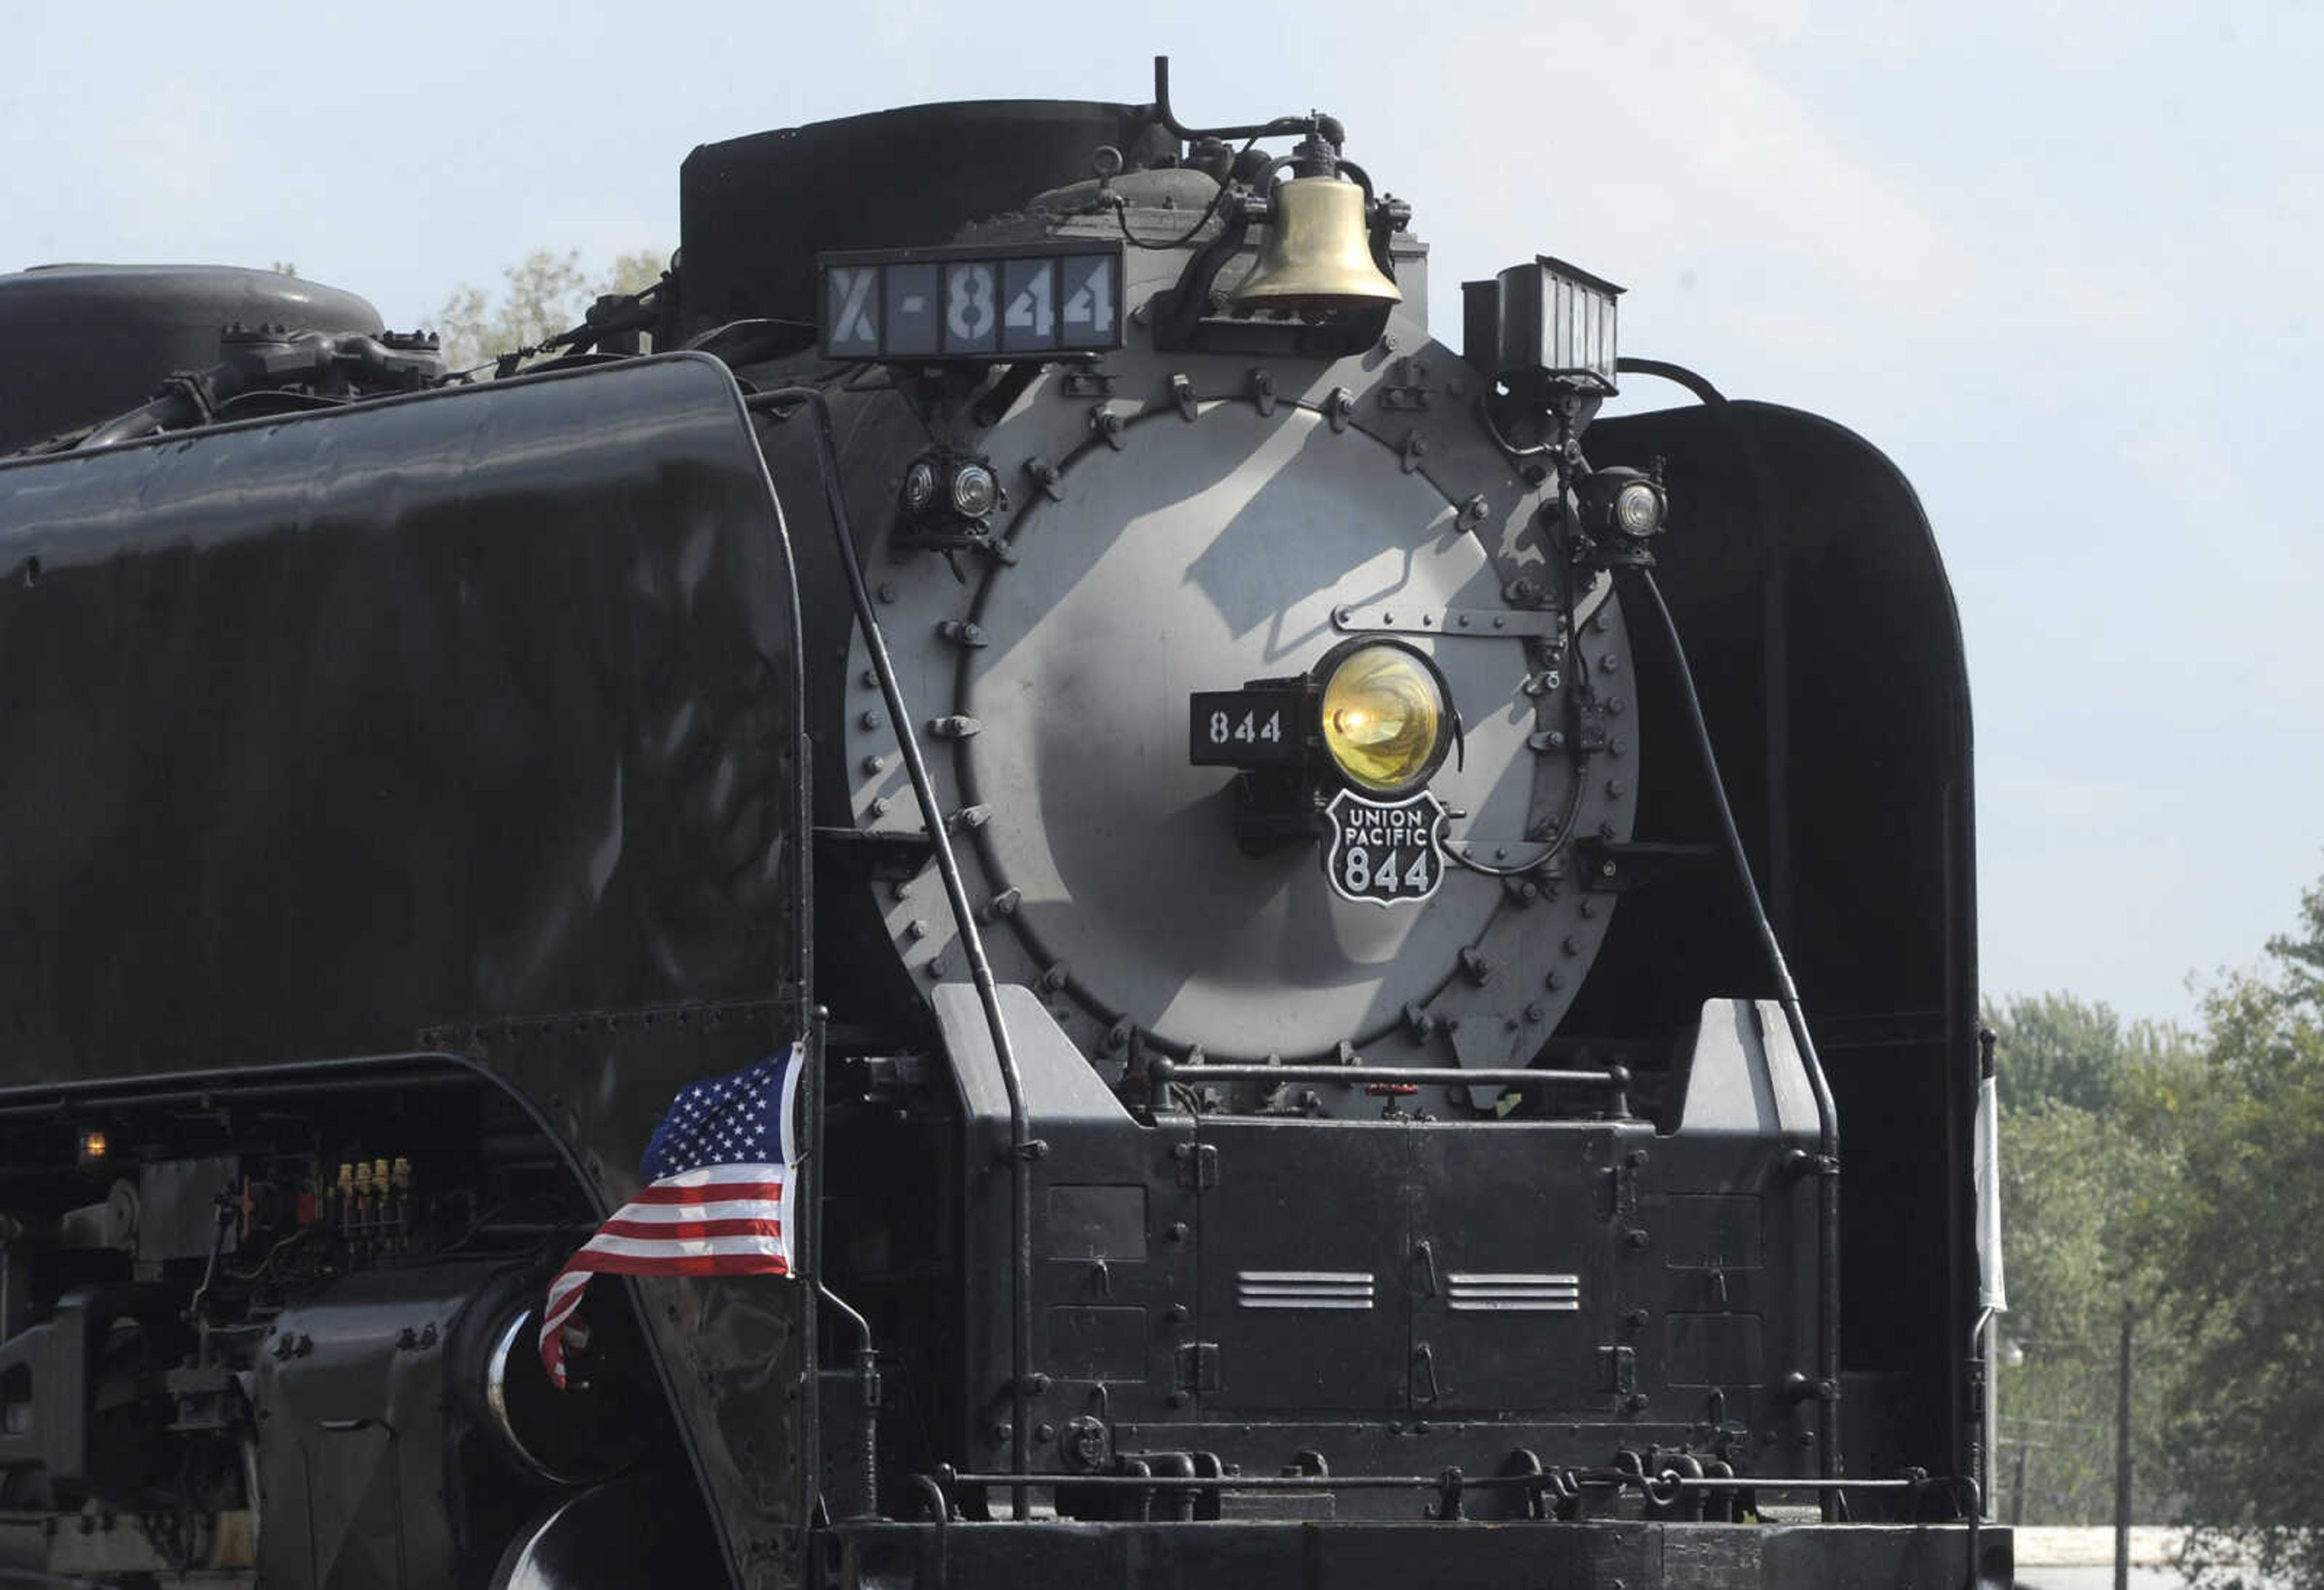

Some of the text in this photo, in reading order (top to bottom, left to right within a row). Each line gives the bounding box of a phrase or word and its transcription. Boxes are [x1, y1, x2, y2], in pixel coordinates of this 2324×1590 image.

[829, 256, 1114, 341] X-844
[1210, 710, 1281, 744] 844
[1350, 810, 1422, 826] UNION
[1345, 828, 1428, 846] PACIFIC
[1345, 847, 1430, 892] 844
